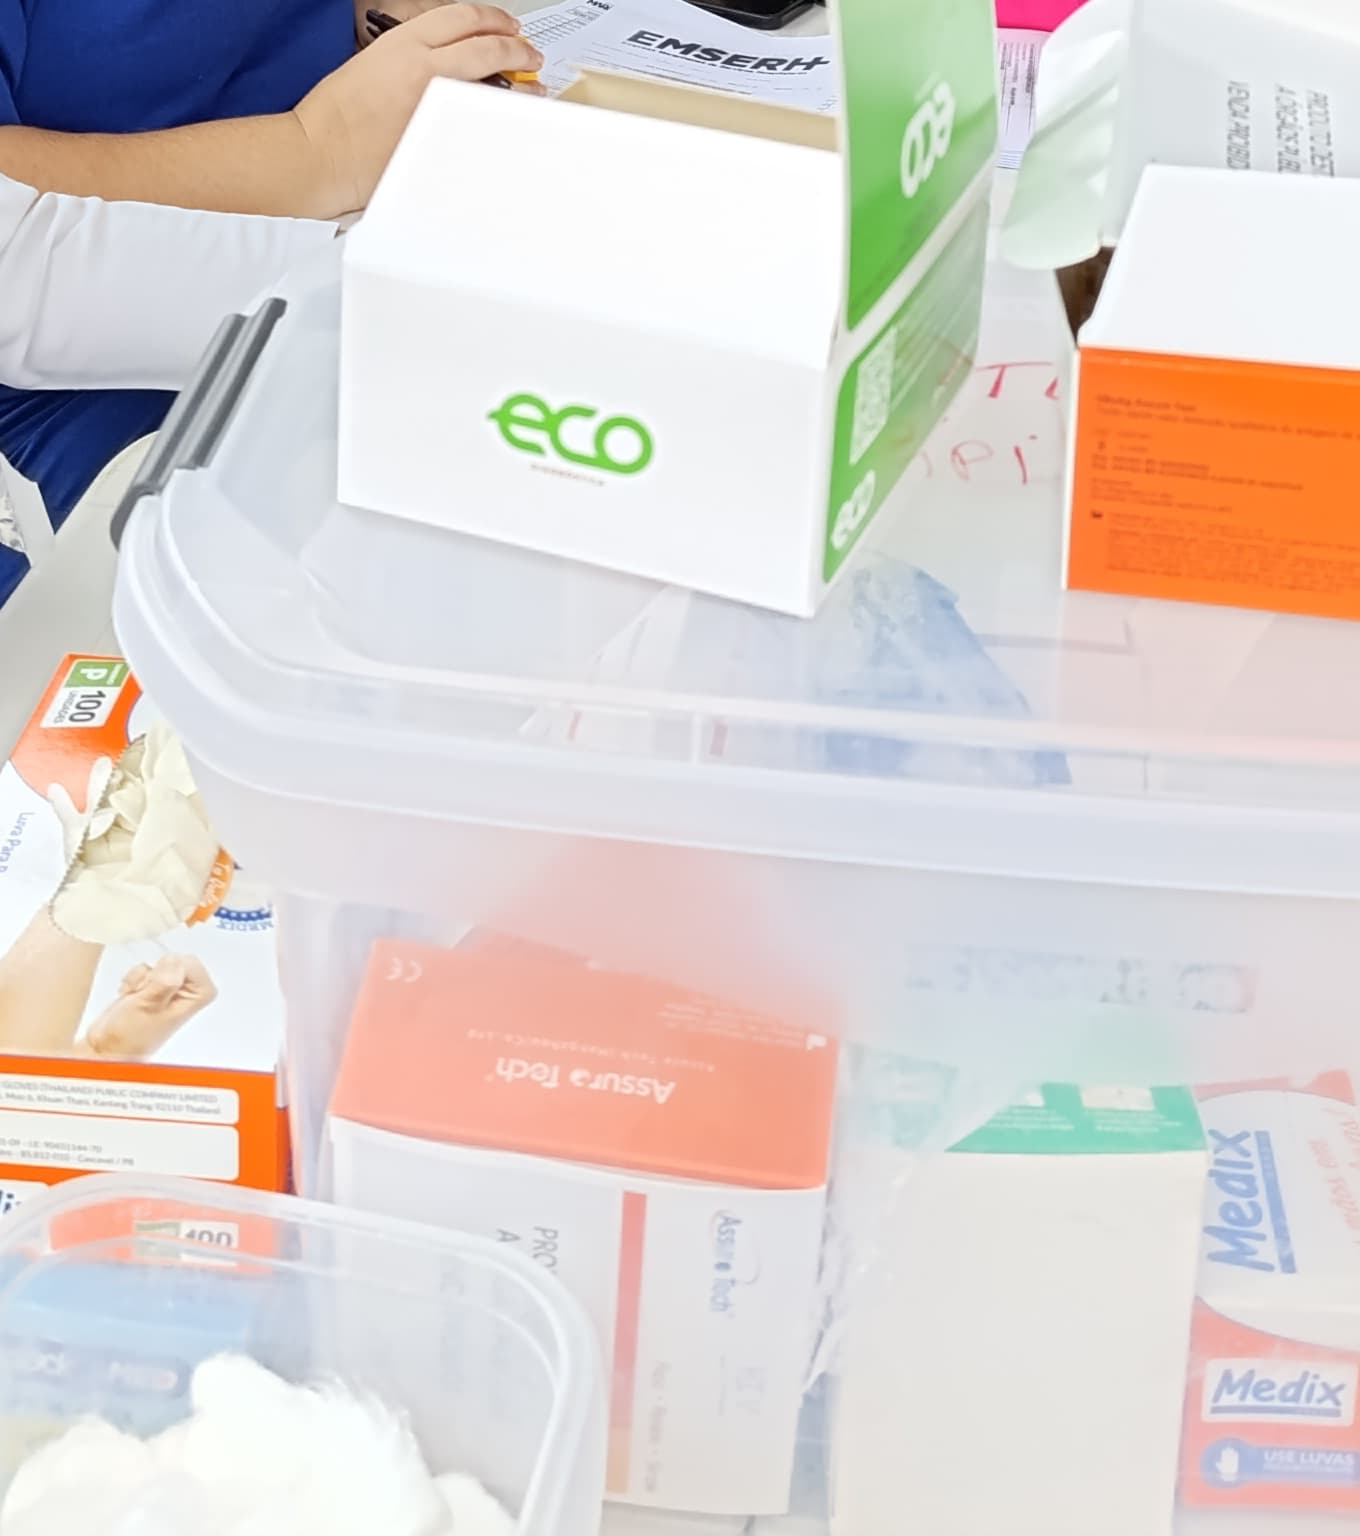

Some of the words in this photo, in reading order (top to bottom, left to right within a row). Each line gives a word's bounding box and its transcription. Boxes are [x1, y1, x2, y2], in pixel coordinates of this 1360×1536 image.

[626, 30, 830, 71] EMSERH
[488, 394, 653, 474] eco
[69, 690, 107, 724] 100
[1202, 1128, 1275, 1272] Medix
[1210, 1369, 1346, 1408] Medix
[1263, 1449, 1295, 1465] USE
[1299, 1450, 1355, 1466] LUVAS
